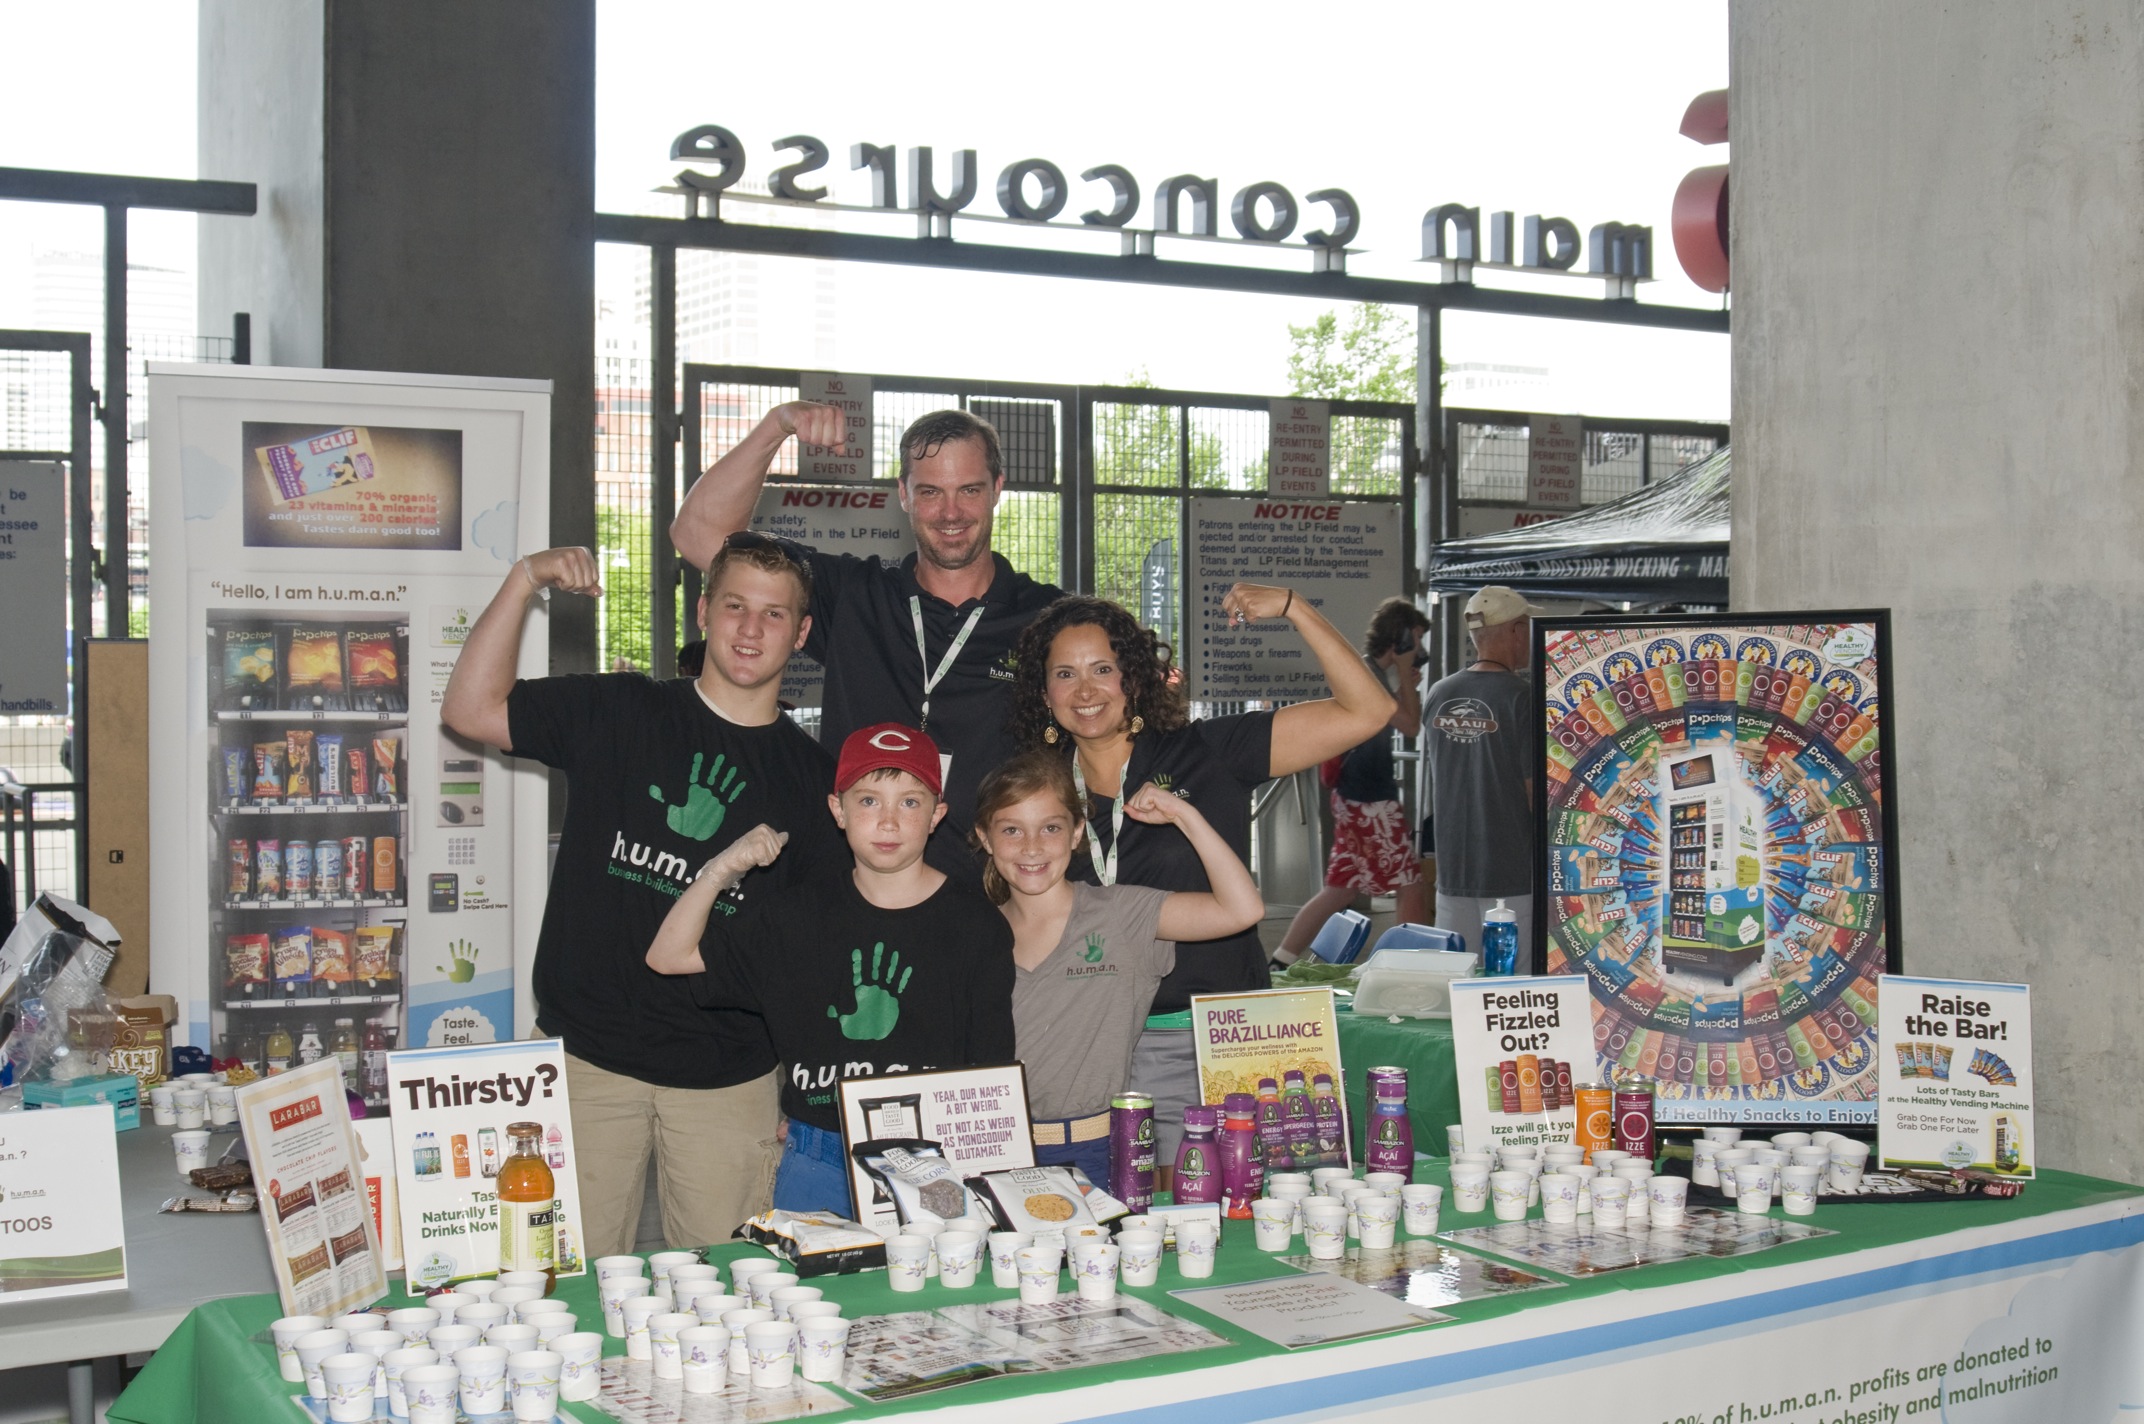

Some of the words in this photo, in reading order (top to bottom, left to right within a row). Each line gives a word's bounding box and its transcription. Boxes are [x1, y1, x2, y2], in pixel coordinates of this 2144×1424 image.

[828, 381, 844, 391] NO
[1293, 407, 1306, 416] NO
[1276, 423, 1322, 434] RE-ENTRY
[319, 430, 356, 450] CLIF
[1274, 438, 1325, 449] PERMITTED
[1282, 452, 1316, 463] DURING
[813, 463, 856, 474] EVENTS
[1275, 466, 1289, 476] LP
[1292, 467, 1323, 477] FIELD
[1281, 481, 1316, 491] EVENTS
[9, 488, 27, 501] be
[356, 491, 385, 501] 70%
[782, 490, 888, 509] NOTICE
[289, 501, 304, 510] 23
[309, 502, 364, 512] vitamins
[369, 503, 379, 512] &
[1254, 504, 1342, 520] NOTICE
[269, 512, 292, 521] and
[297, 513, 322, 523] just
[327, 514, 354, 522] over
[360, 514, 384, 523] 200
[303, 525, 344, 534] Tastes
[349, 526, 377, 534] darn
[381, 527, 411, 537] good
[415, 527, 440, 536] too!
[1199, 520, 1233, 530] Patrons
[1238, 522, 1275, 532] entering
[1280, 522, 1293, 531] the
[1298, 522, 1312, 532] LP
[1315, 523, 1338, 532] Field
[1343, 525, 1361, 534] may
[1365, 524, 1376, 533] be
[1199, 532, 1233, 543] ejected
[1271, 534, 1308, 543] arrested
[1312, 534, 1324, 544] for
[1329, 535, 1364, 545] conduct
[1200, 544, 1236, 553] deemed
[1241, 545, 1300, 556] unacceptable
[1304, 546, 1315, 557] by
[1320, 547, 1333, 556] the
[1339, 547, 1384, 557] Tennessee
[1200, 556, 1227, 565] Titans
[1232, 556, 1249, 565] and
[1259, 556, 1273, 566] LP
[1276, 557, 1300, 566] Field
[1304, 557, 1369, 569] Management
[1537, 558, 1609, 577] MOISTURE
[1613, 557, 1680, 577] WICKING
[275, 585, 279, 599] I
[285, 587, 312, 599] am
[1212, 636, 1235, 647] Illegal
[1240, 637, 1262, 646] drugs
[788, 662, 821, 672] refuse
[1440, 718, 1487, 728] MAUI
[869, 730, 911, 751] C
[1067, 964, 1119, 976] h.u.m.a.n.
[1483, 990, 1559, 1011] Feeling
[1922, 993, 1991, 1017] Raise
[443, 1018, 479, 1029] Taste.
[1208, 1009, 1247, 1026] PURE
[1486, 1010, 1560, 1032] Fizzled
[1210, 1022, 1323, 1044] BRAZILLIANCE
[1905, 1015, 1948, 1037] the
[1956, 1018, 2008, 1041] Bar!
[444, 1033, 473, 1044] Feel.
[1500, 1032, 1550, 1052] Out?
[400, 1063, 558, 1111] Thirsty?
[1917, 1086, 1937, 1095] Lots
[1939, 1087, 1949, 1096] of
[1951, 1088, 1977, 1098] Tasty
[1979, 1089, 2000, 1098] Bars
[933, 1090, 958, 1103] YEAH,
[960, 1088, 977, 1100] OUR
[979, 1085, 1010, 1099] NAME'S
[946, 1105, 953, 1115] A
[955, 1103, 968, 1114] BIT
[970, 1100, 1001, 1113] WEIRD.
[1896, 1096, 1909, 1104] the
[1911, 1096, 1947, 1107] Healthy
[1950, 1098, 1989, 1110] Vending
[1990, 1101, 2030, 1111] Machine
[1655, 1107, 1668, 1120] of
[1674, 1107, 1737, 1123] Healthy
[1743, 1108, 1801, 1122] Snacks
[1807, 1109, 1822, 1122] to
[1828, 1108, 1878, 1123] Enjoy!
[1897, 1113, 1918, 1123] Grab
[1919, 1114, 1939, 1123] One
[1940, 1115, 1955, 1124] For
[1957, 1116, 1977, 1125] Now
[936, 1124, 952, 1136] BUT
[955, 1121, 971, 1134] NOT
[974, 1120, 986, 1130] AS
[987, 1116, 1016, 1130] WEIRD
[1491, 1124, 1513, 1135] Izze
[1515, 1122, 1535, 1133] will
[1536, 1122, 1555, 1135] get
[1897, 1122, 1918, 1131] Grab
[1919, 1123, 1938, 1132] One
[1940, 1124, 1955, 1133] For
[1957, 1125, 1979, 1134] Later
[944, 1138, 956, 1149] AS
[958, 1130, 1013, 1147] MONOSODIUM
[1502, 1134, 1539, 1147] feeling
[1541, 1132, 1570, 1145] Fizzy
[1592, 1142, 1609, 1150] IZZE
[955, 1145, 1006, 1161] GLUTAMATE.
[1625, 1142, 1645, 1151] IZZE
[1178, 1168, 1210, 1176] SAMBAZON
[1022, 1186, 1054, 1194] OLIVE
[422, 1204, 486, 1223] Naturally
[421, 1222, 466, 1239] Drinks
[468, 1221, 498, 1234] Now
[1224, 1294, 1284, 1306] Yourself
[1307, 1286, 1336, 1295] ONE
[1225, 1288, 1275, 1299] Please
[1281, 1282, 1315, 1293] Help
[1297, 1297, 1312, 1305] of
[1313, 1291, 1357, 1301] Each
[1276, 1301, 1339, 1313] Product
[1740, 1387, 1842, 1423] h.u.m.a.n.
[1850, 1368, 1910, 1399] profits
[1917, 1361, 1947, 1383] are
[1953, 1337, 2030, 1374] donated
[2035, 1336, 2053, 1355] to
[1906, 1388, 1941, 1417] and
[1948, 1366, 2058, 1406] malnutrition
